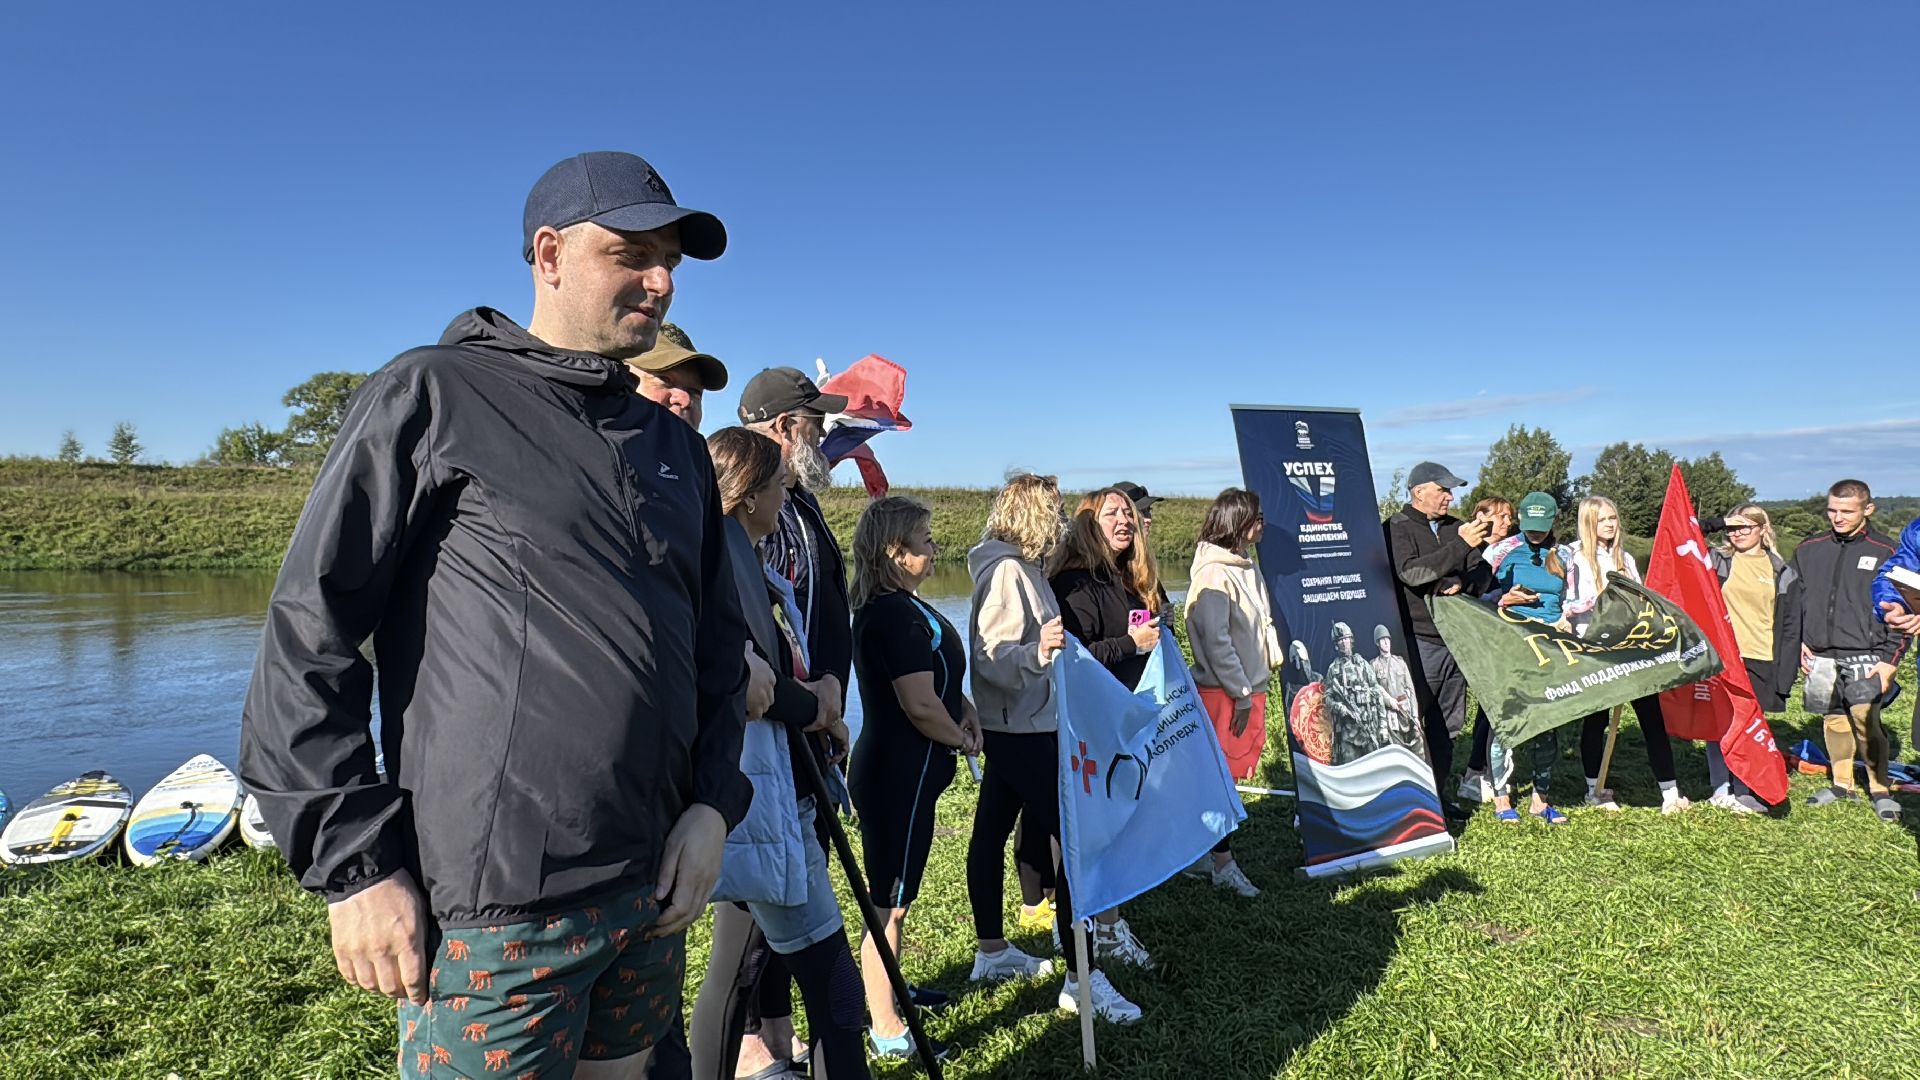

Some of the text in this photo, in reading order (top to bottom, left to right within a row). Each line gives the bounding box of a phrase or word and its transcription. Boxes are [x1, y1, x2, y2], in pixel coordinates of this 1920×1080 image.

[1283, 462, 1335, 476] УСПЕХ
[1300, 523, 1343, 533] ЕДИНСТВЕ
[1299, 531, 1348, 543] ПОКОЛЕНИЙ
[1544, 680, 1583, 700] Фонд
[1580, 659, 1656, 688] поддержки
